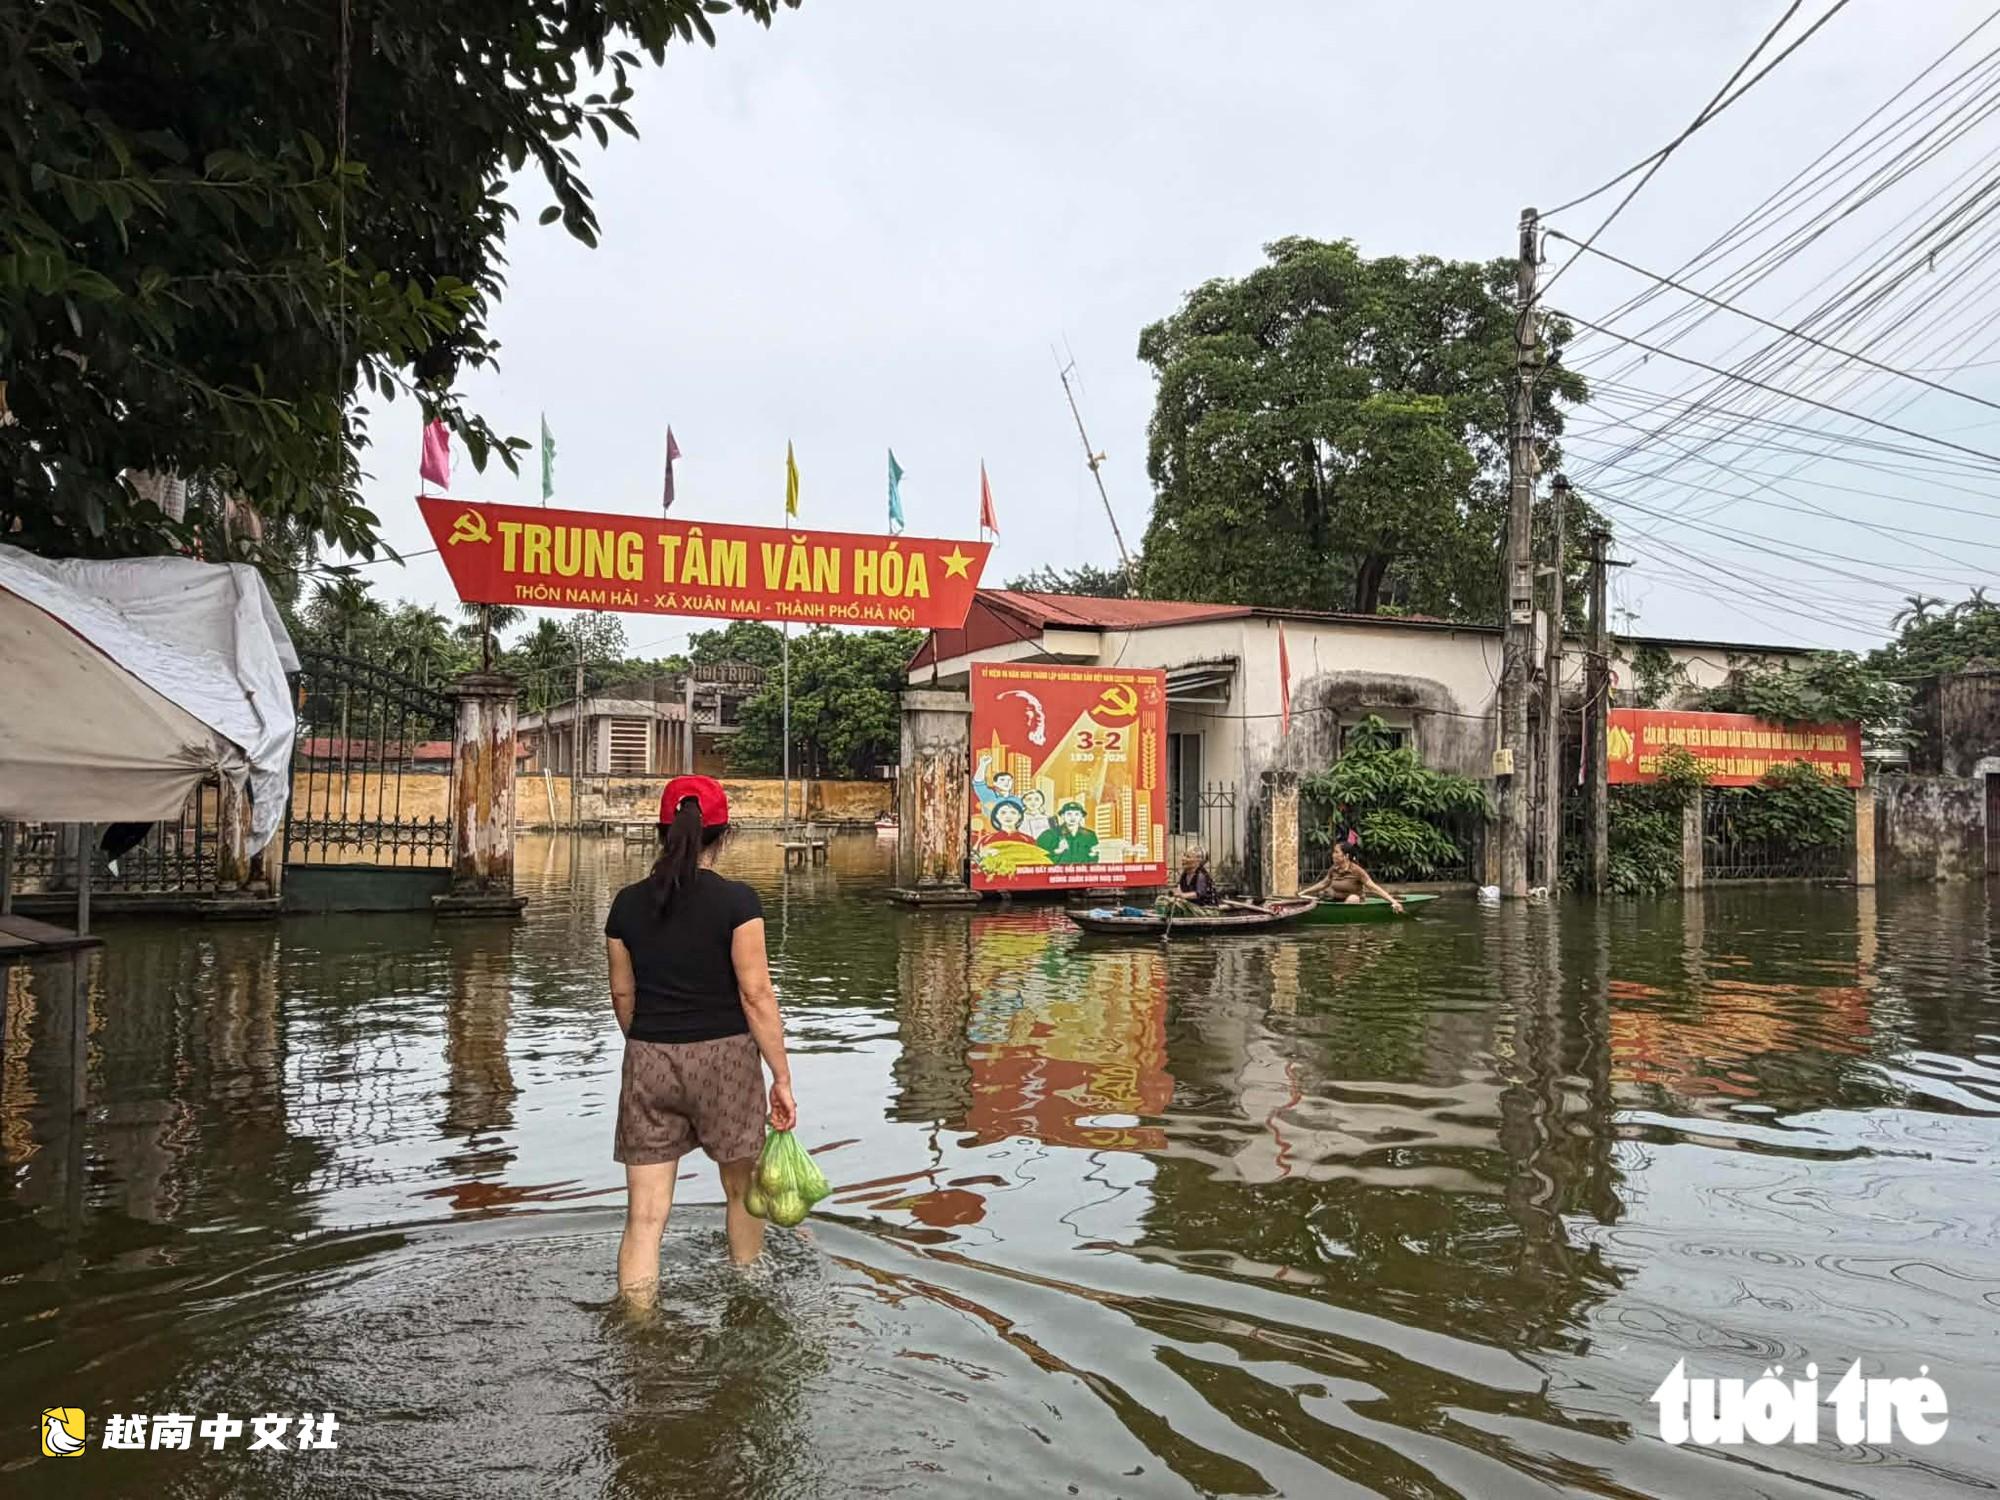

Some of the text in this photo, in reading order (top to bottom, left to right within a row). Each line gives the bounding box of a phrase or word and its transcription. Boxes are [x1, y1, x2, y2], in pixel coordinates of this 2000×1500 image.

[497, 521, 930, 599] TRUNG TÂM VĂN HÓA
[515, 584, 561, 600] THÔN
[566, 588, 606, 604] NAM
[654, 592, 678, 609] XÃ
[681, 594, 726, 611] XUÂN
[731, 599, 761, 614] MAI
[775, 599, 825, 617] THÀNH
[889, 605, 915, 624] NỘI
[1077, 731, 1121, 750] 3-2
